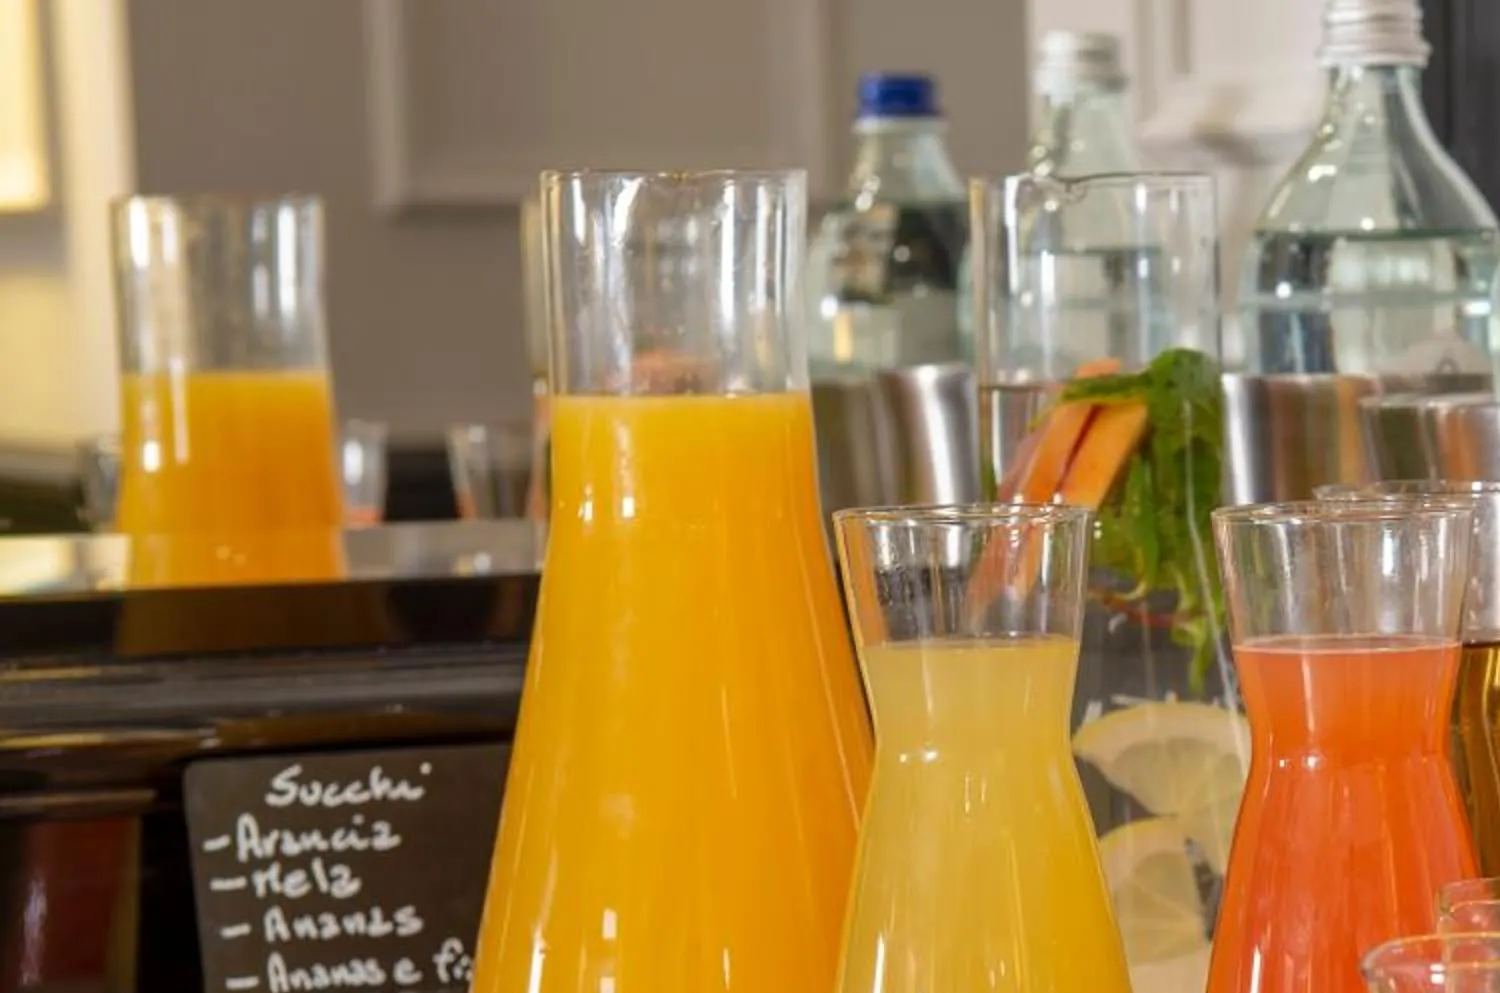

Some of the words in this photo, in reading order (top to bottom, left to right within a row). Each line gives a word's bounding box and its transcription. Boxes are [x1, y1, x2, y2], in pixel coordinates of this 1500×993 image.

[264, 762, 432, 807] Succhi
[236, 812, 401, 863] Arancia
[251, 857, 362, 899] Mela
[263, 905, 423, 943] Ananas
[393, 957, 422, 985] e
